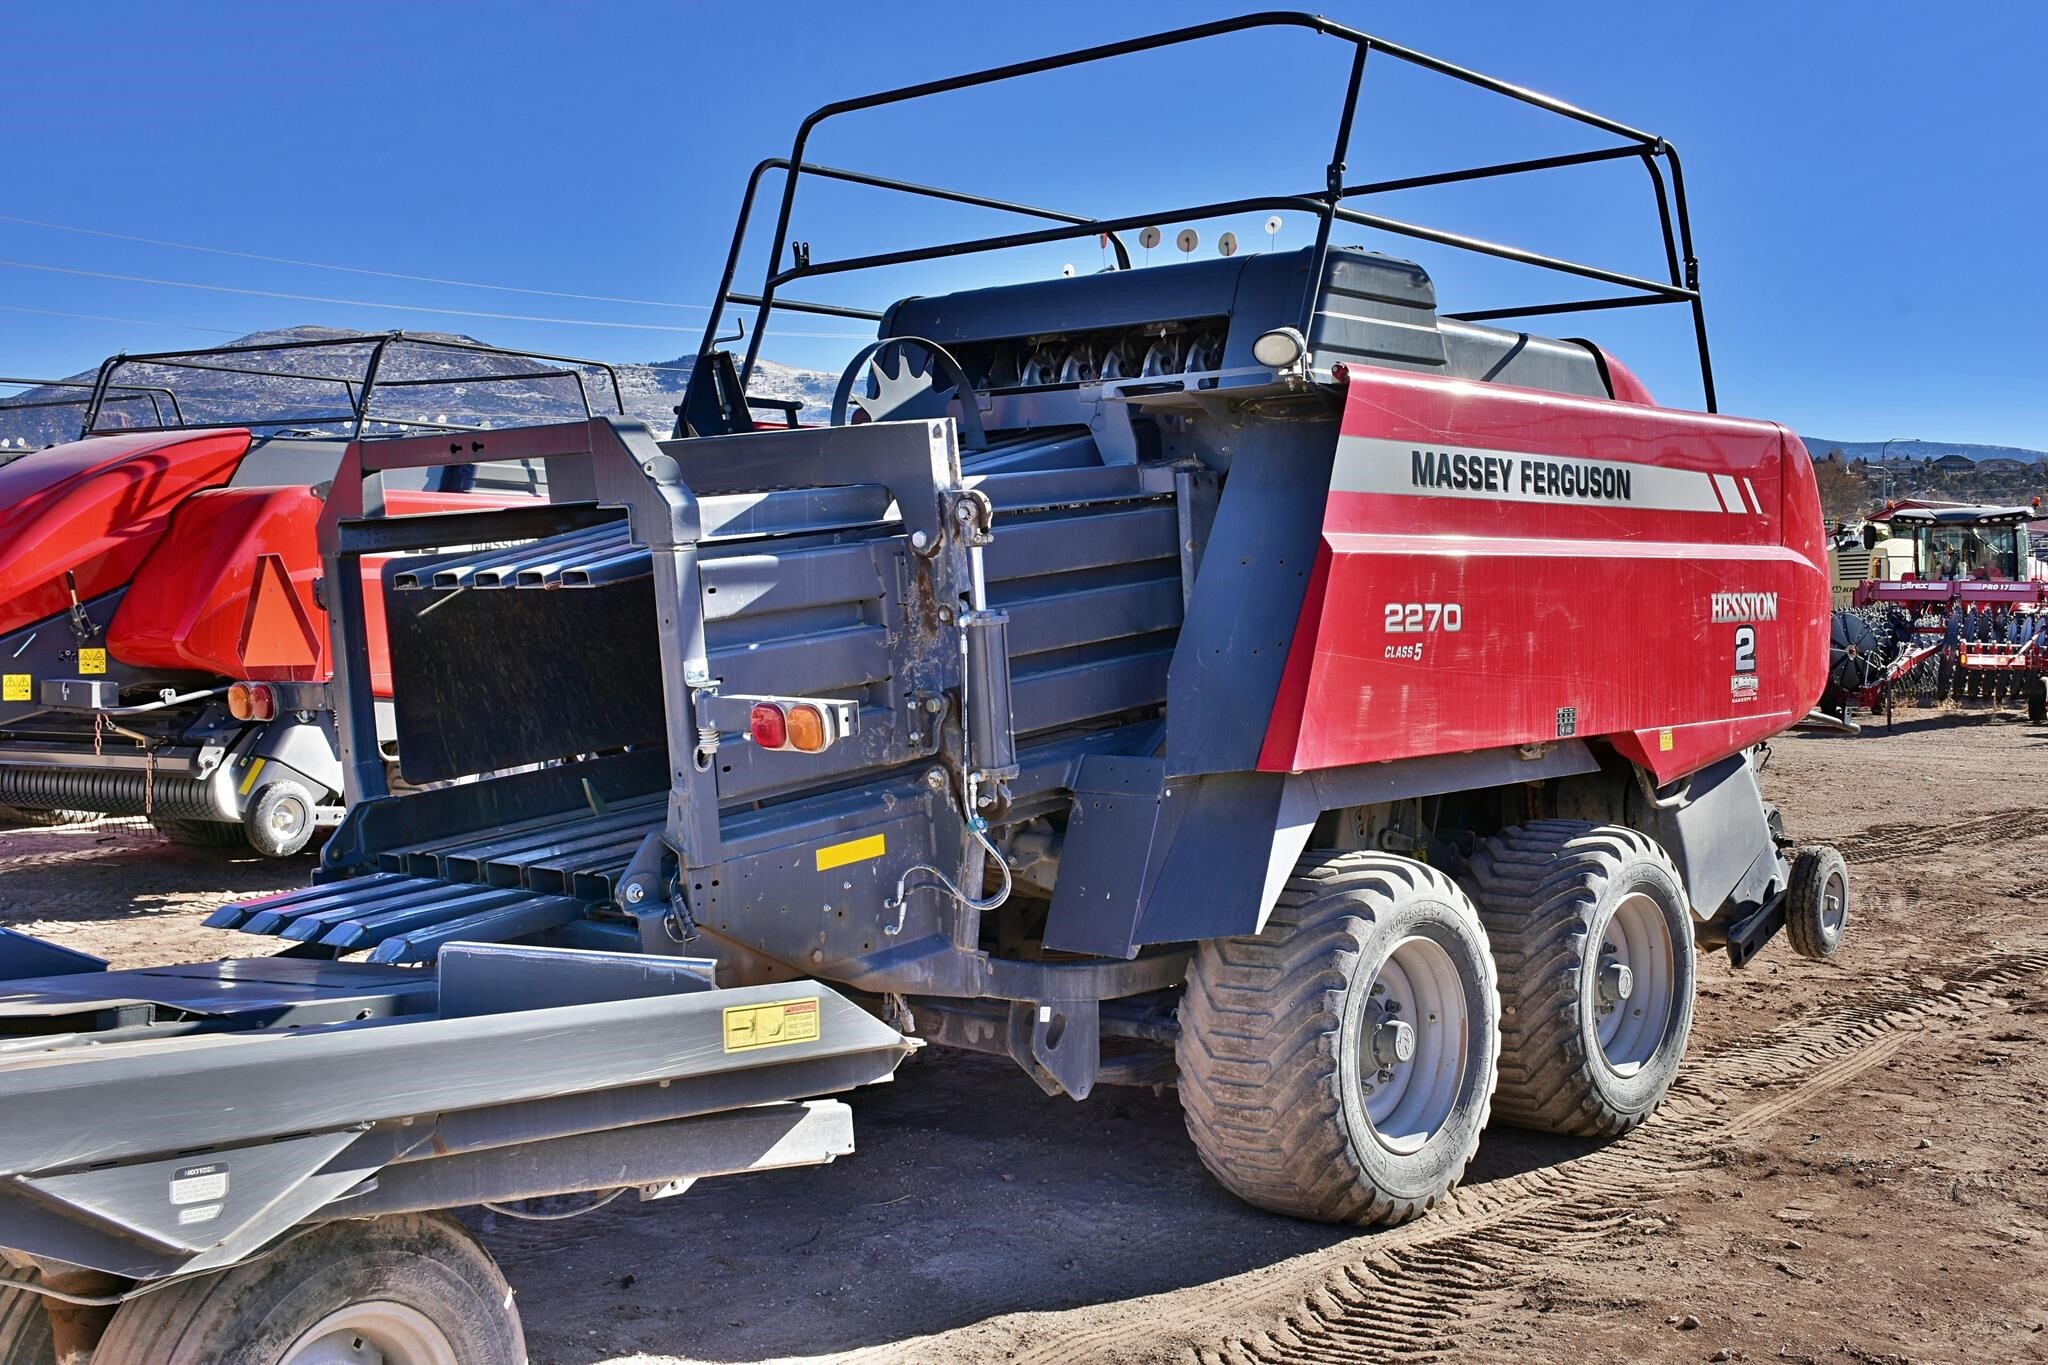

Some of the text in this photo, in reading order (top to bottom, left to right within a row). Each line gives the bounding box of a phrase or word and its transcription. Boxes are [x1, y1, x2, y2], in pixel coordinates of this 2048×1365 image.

[1412, 451, 1632, 500] MASSEY FERGUSON
[1384, 602, 1463, 633] 2270
[1711, 591, 1778, 623] HESSTON
[1384, 641, 1423, 661] CLASS 5
[1734, 624, 1756, 673] 2
